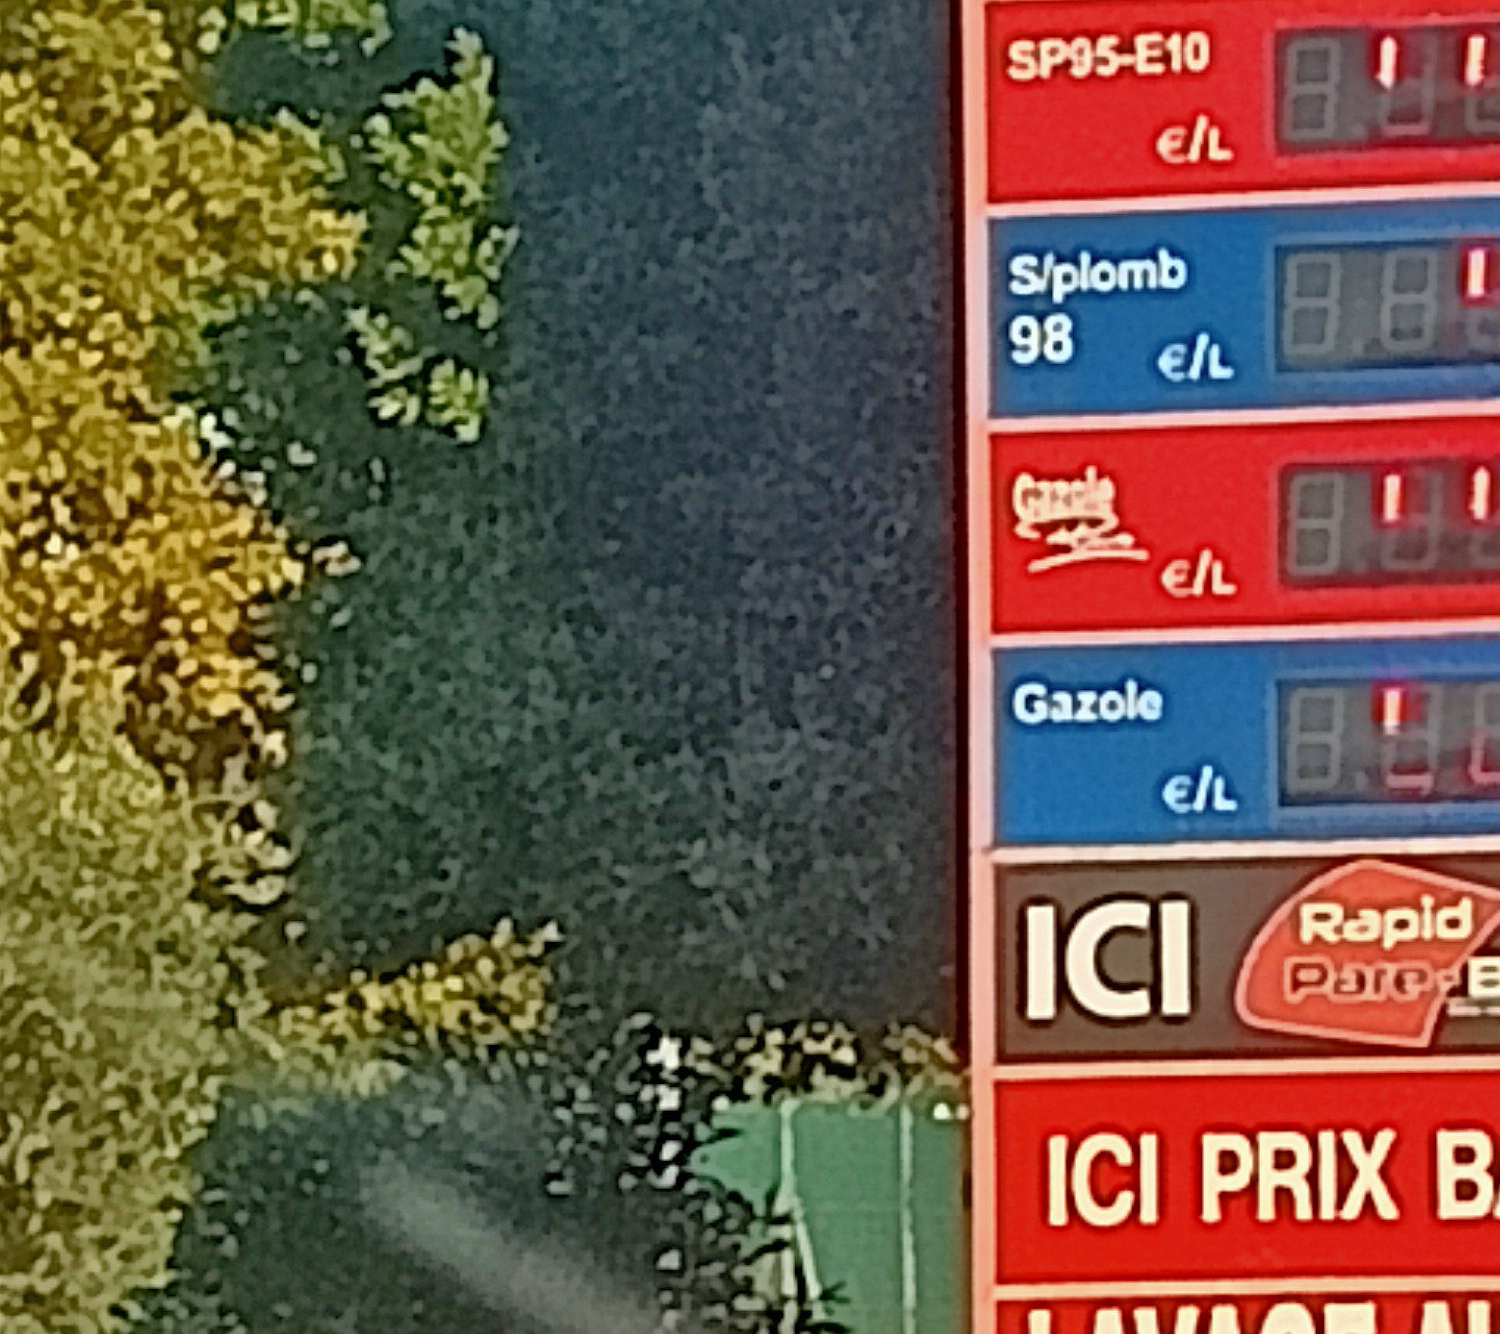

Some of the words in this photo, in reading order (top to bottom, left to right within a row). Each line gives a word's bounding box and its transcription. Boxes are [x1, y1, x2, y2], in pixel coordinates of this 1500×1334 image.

[1007, 31, 1210, 81] SP95-E10
[1157, 115, 1233, 164] €/L
[1009, 248, 1187, 304] S/plomb
[1010, 313, 1074, 365] 98
[1158, 333, 1233, 380] €/L
[1161, 549, 1236, 597] €/L
[1013, 679, 1163, 724] Gazole
[1162, 765, 1238, 813] €/L
[1299, 895, 1474, 950] Rapid
[1026, 899, 1191, 1020] ICI
[1048, 1132, 1158, 1227] ICI
[1201, 1128, 1400, 1224] PRIX
